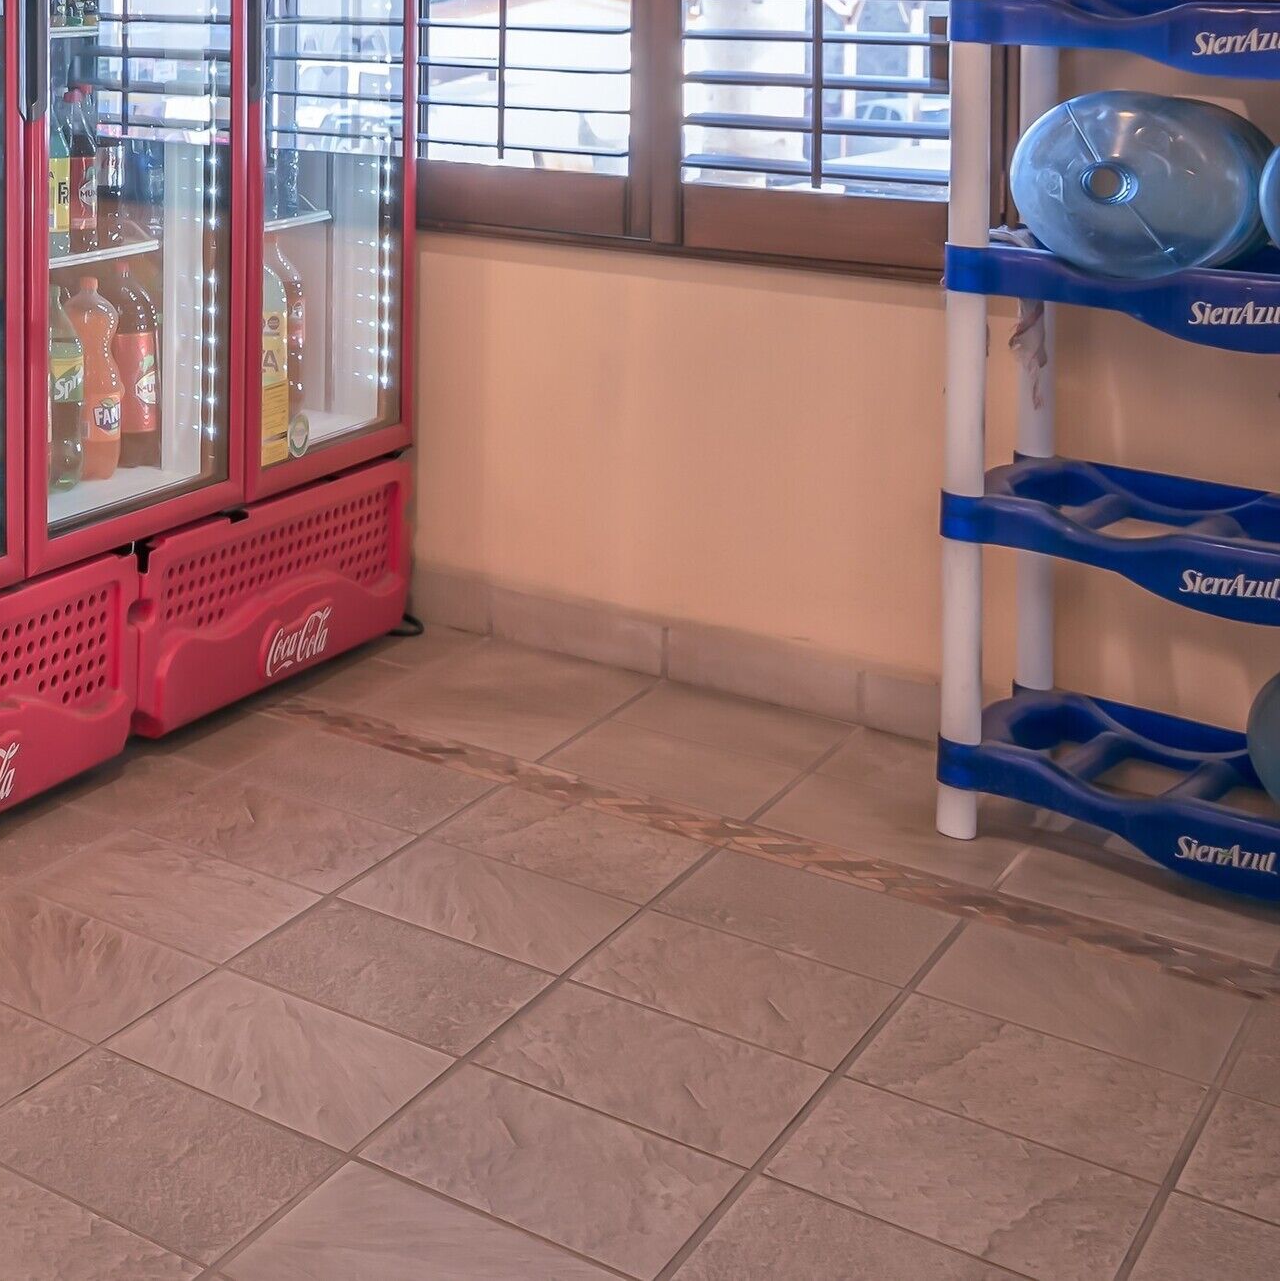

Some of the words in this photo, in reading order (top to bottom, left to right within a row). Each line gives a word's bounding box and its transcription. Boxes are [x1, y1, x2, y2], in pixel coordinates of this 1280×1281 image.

[1188, 300, 1280, 326] SierrAzu
[93, 401, 120, 428] FAN
[1179, 569, 1280, 601] SierrAzul
[1175, 836, 1278, 875] SierrAzul
